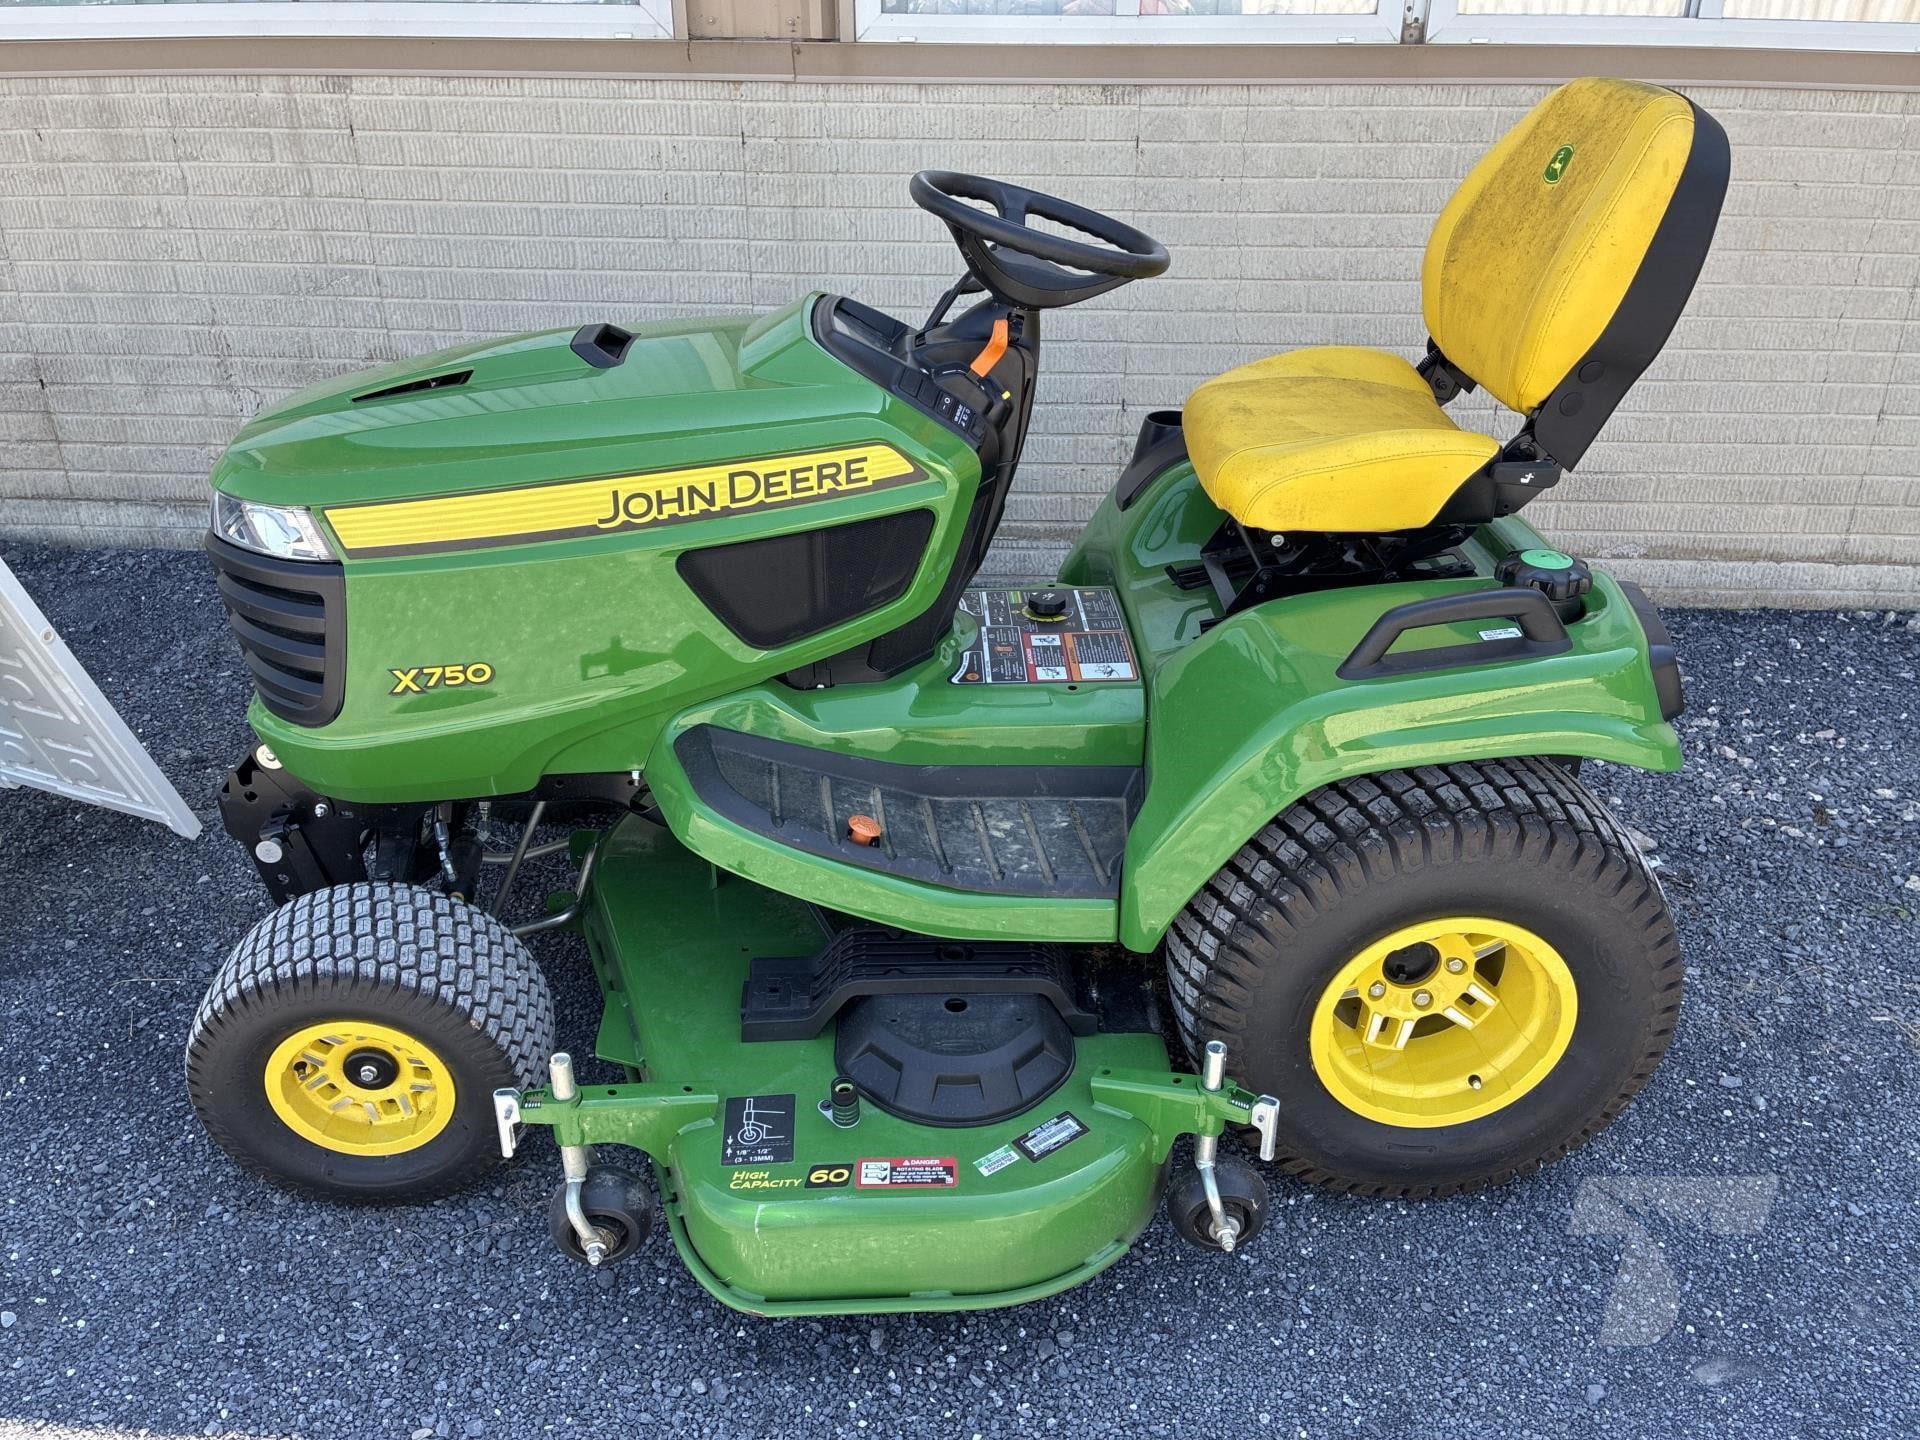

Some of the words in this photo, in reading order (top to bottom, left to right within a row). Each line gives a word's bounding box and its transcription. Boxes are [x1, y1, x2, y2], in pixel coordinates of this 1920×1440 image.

[598, 481, 716, 525] JOHN
[728, 456, 869, 505] DEERE
[388, 662, 494, 695] X750
[729, 1178, 803, 1189] CAPACITY
[732, 1171, 770, 1180] HIGH
[809, 1168, 850, 1184] 60
